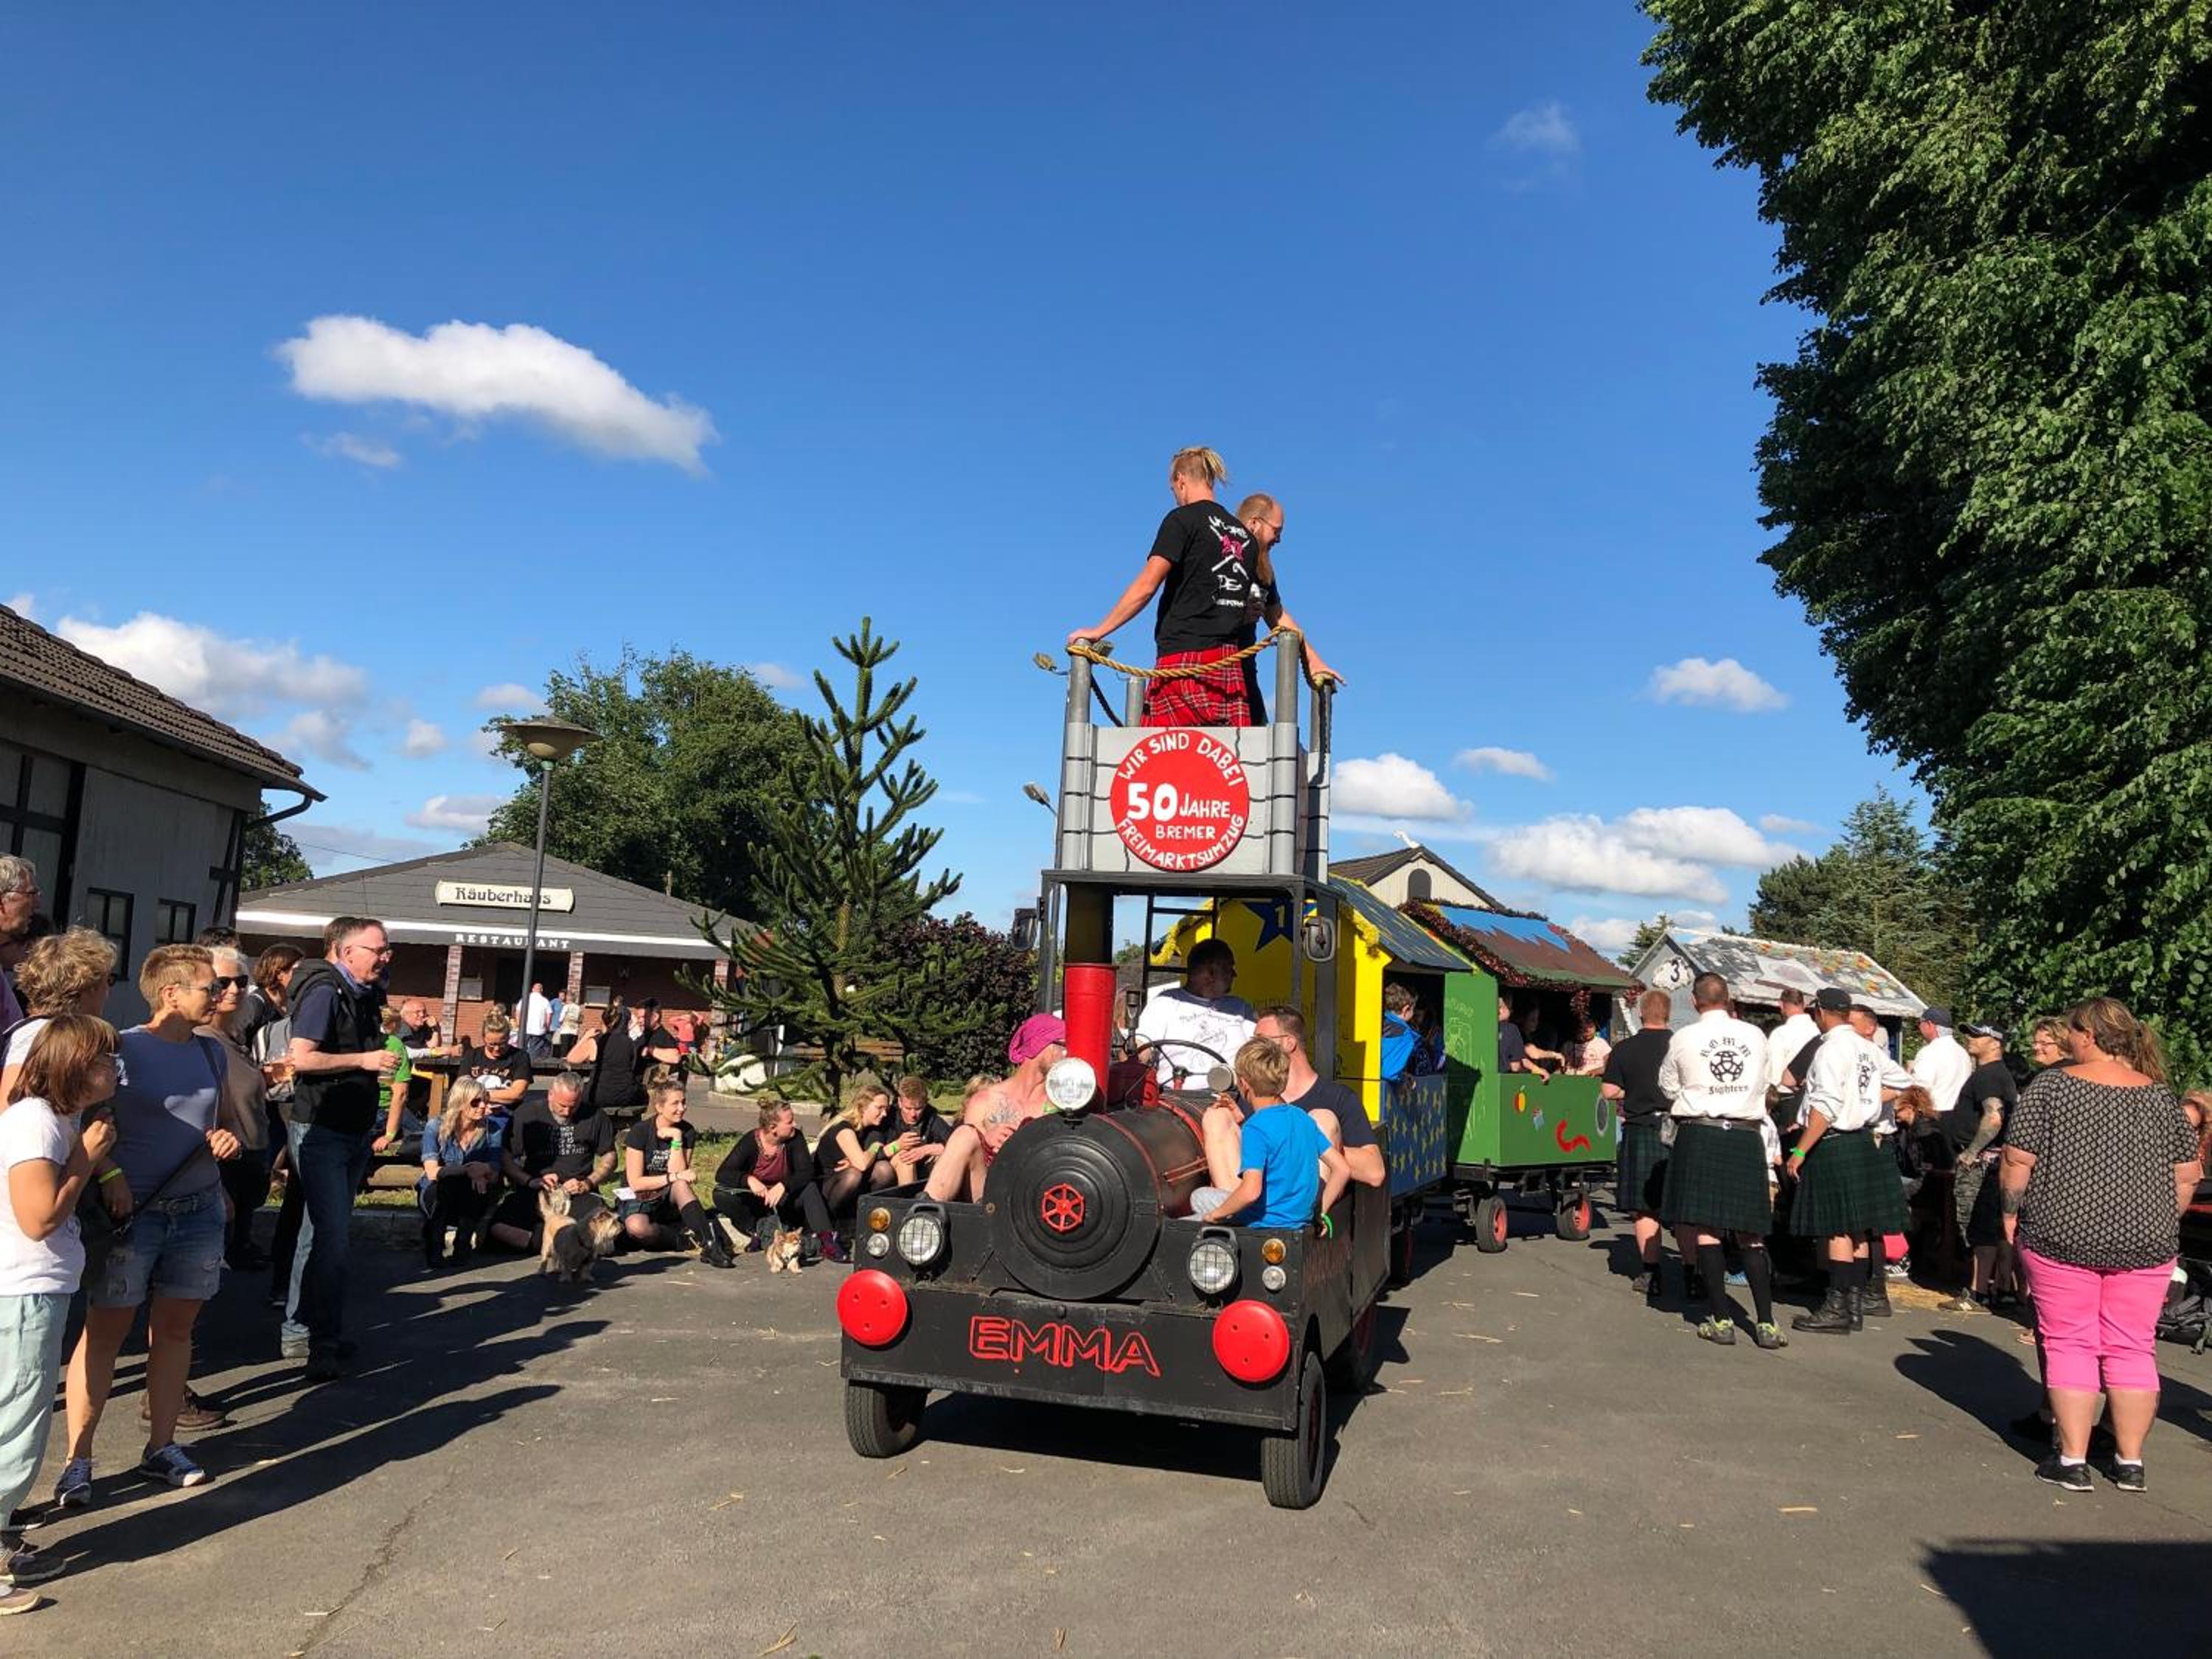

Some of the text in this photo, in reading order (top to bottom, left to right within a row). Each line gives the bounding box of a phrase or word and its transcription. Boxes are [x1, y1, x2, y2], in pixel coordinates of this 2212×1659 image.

[1117, 732, 1244, 787] WIR SIND DABEI
[1127, 782, 1231, 822] 50 JAHRE
[1115, 813, 1245, 870] FREIMARKTSUMZUG
[1155, 824, 1216, 841] BREMER
[455, 886, 551, 905] Räuberhas
[1275, 904, 1285, 928] 1
[455, 933, 570, 950] RESTAUANT
[1670, 959, 1680, 983] 3
[969, 1315, 1162, 1378] EMMA
